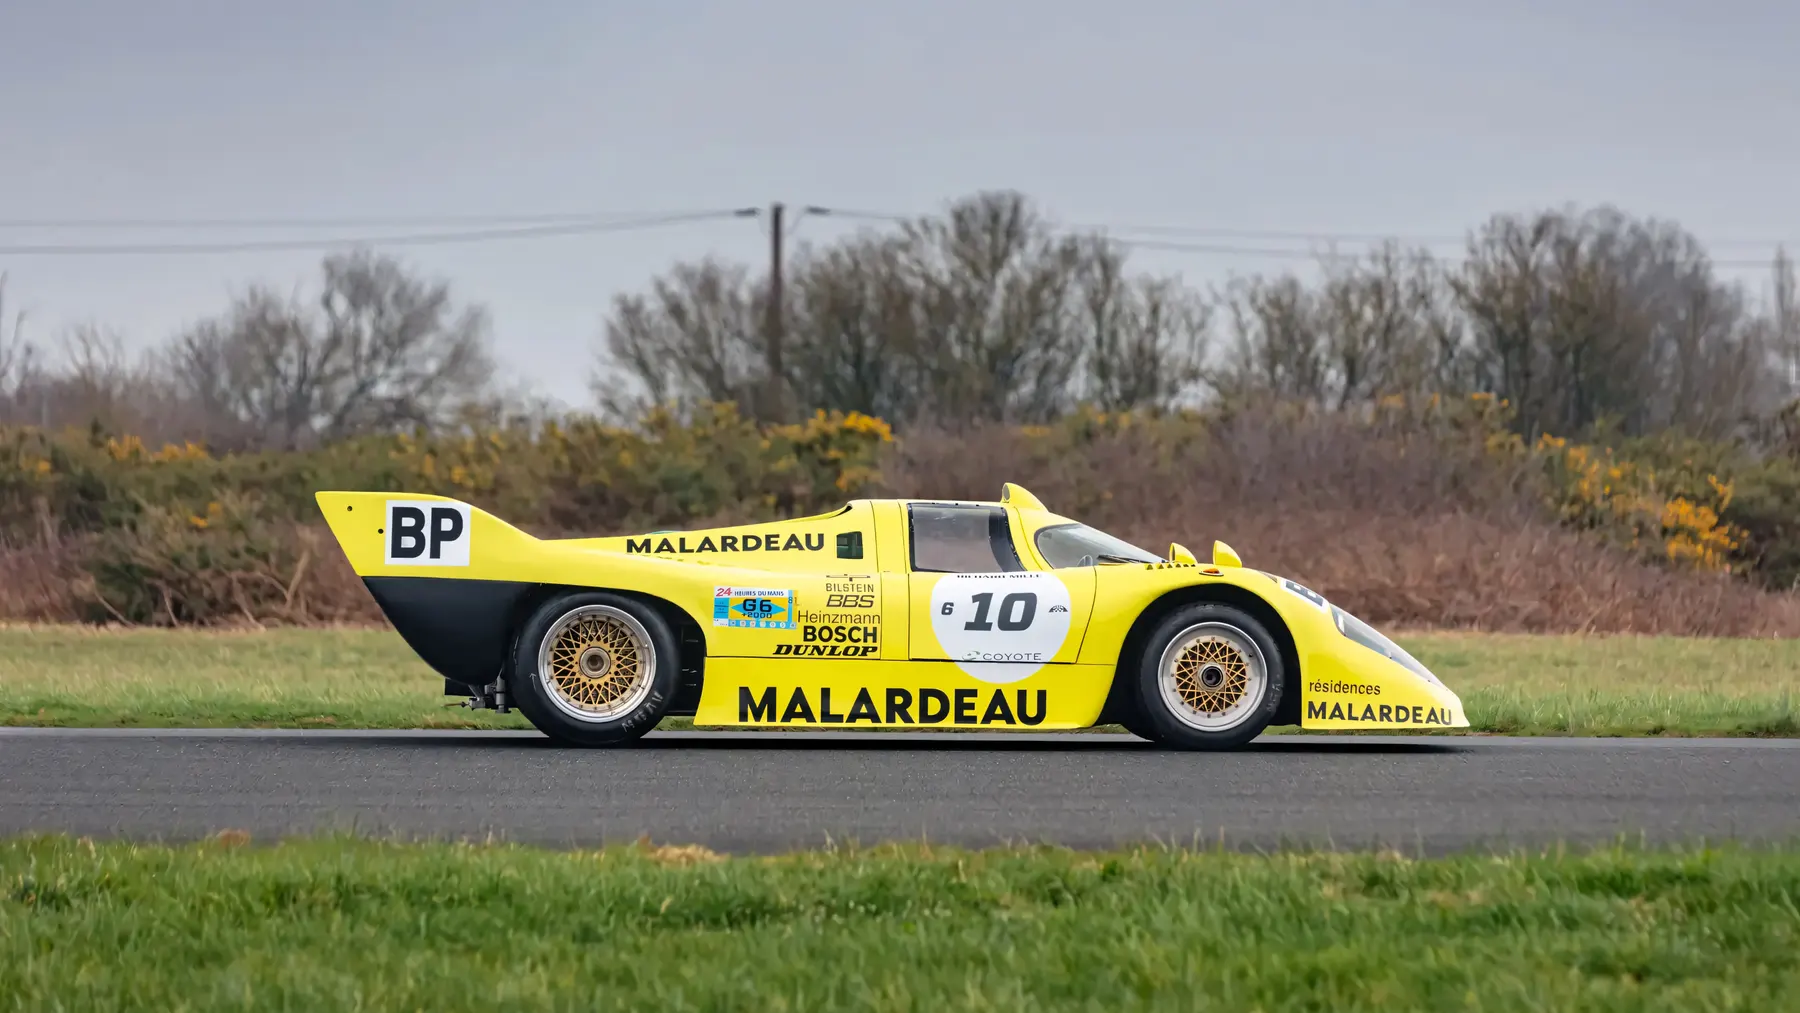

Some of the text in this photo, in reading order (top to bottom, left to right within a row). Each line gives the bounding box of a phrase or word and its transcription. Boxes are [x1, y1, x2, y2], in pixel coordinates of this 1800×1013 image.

[391, 506, 463, 559] BP
[626, 533, 825, 554] MALARDEAU
[716, 587, 732, 597] 24
[825, 583, 874, 593] BILSTEIN
[742, 598, 773, 613] G6
[826, 594, 875, 608] BBS
[941, 602, 954, 615] 6
[797, 610, 881, 625] Heinzmann
[964, 592, 1038, 631] 10
[803, 625, 877, 643] BOSCH
[772, 644, 878, 657] DUNLOP
[982, 652, 1042, 661] COYOTE
[1309, 679, 1381, 695] résidences
[738, 686, 1047, 726] MALARDEAU
[1307, 701, 1453, 726] MALARDEAU
